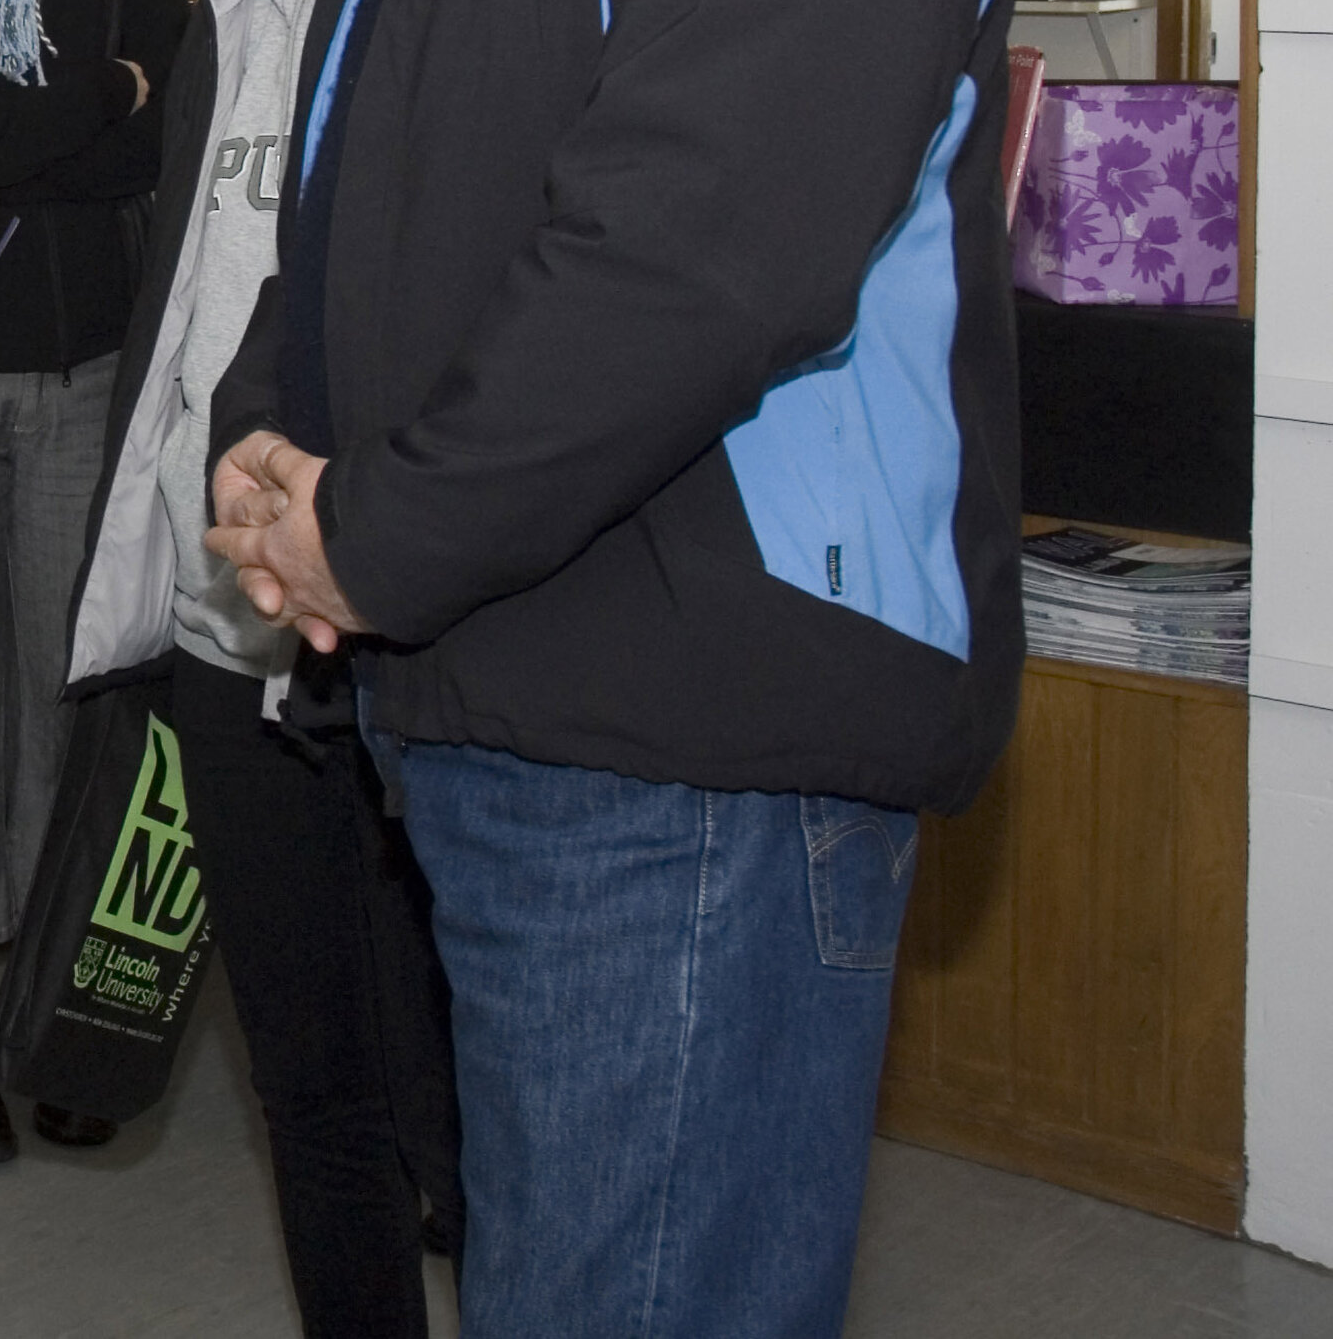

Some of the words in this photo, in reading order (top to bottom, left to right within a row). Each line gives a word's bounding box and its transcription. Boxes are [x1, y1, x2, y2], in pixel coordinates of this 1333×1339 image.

[105, 944, 161, 982] Lincoln
[162, 950, 201, 1022] where
[96, 967, 164, 1014] University
